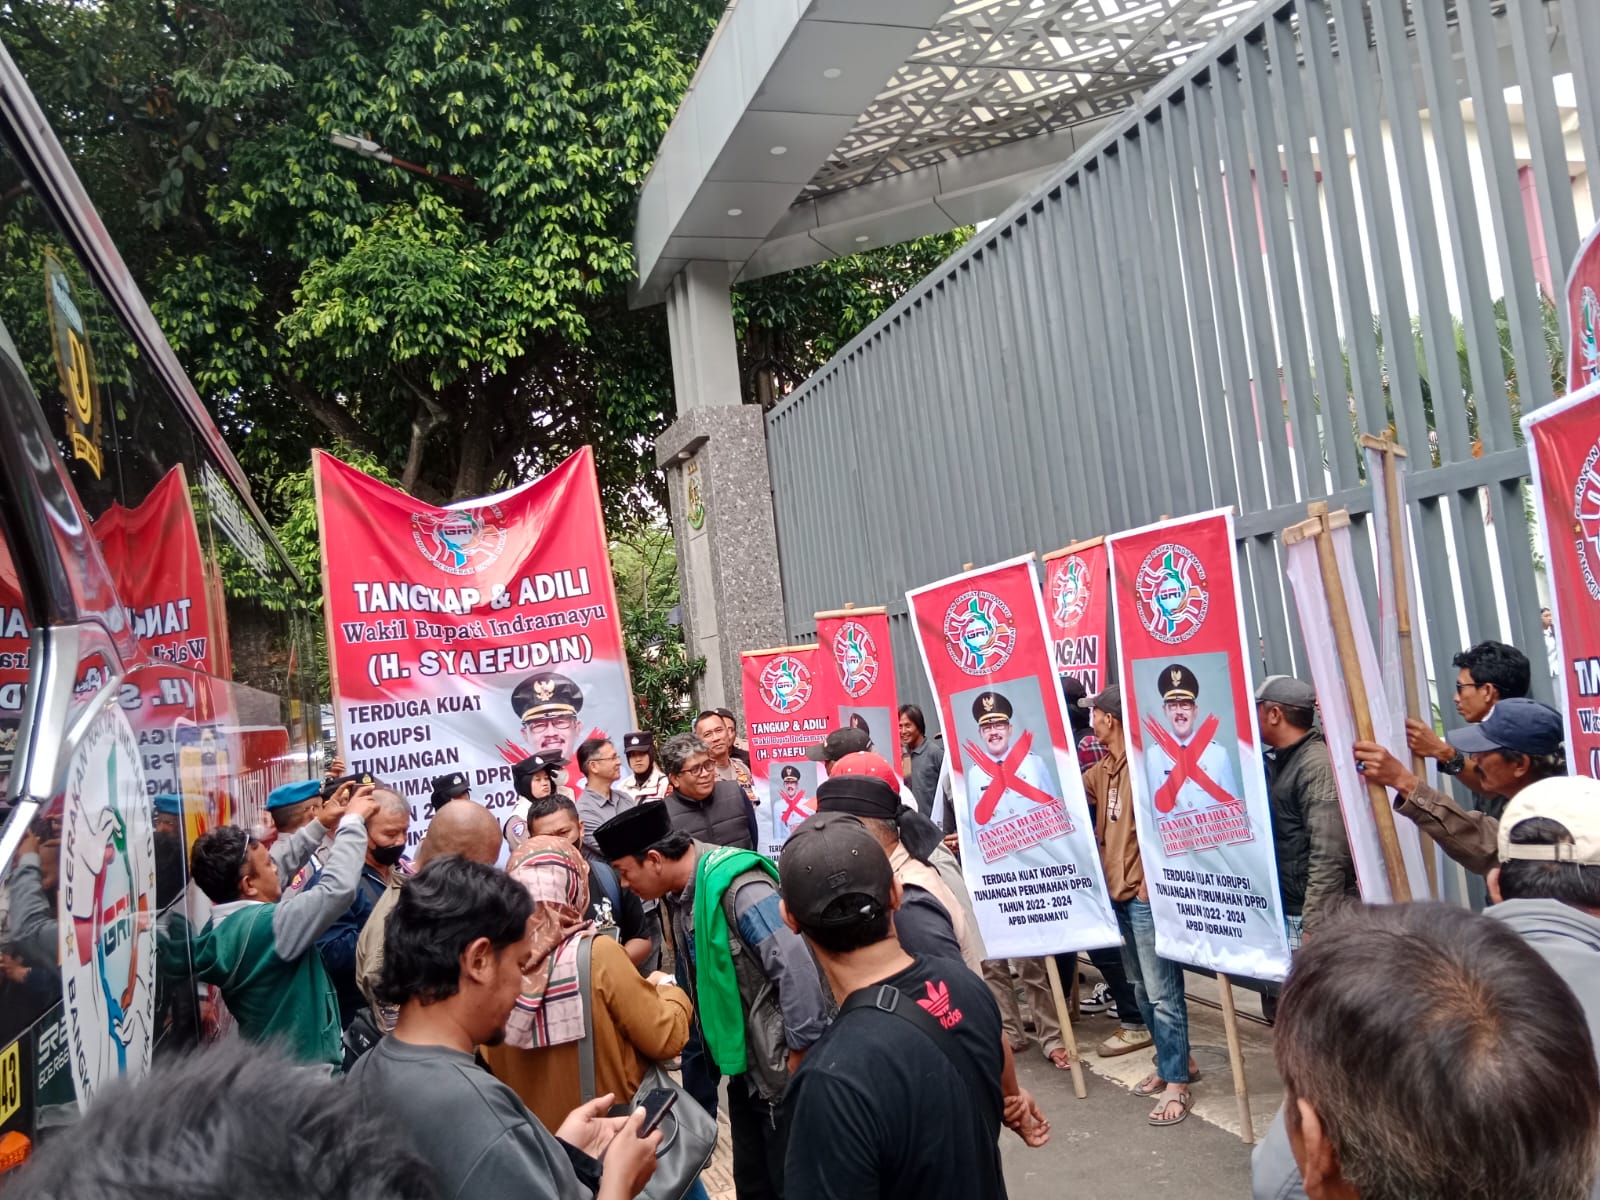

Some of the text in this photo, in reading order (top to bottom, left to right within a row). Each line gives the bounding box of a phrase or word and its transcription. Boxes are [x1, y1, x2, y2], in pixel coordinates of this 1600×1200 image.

[444, 525, 472, 536] GRI
[353, 567, 590, 614] TANGKAP & ADILI
[1160, 587, 1180, 600] GRI
[342, 603, 607, 644] Wakil Bupati Indramayu
[967, 627, 989, 640] GRI
[367, 635, 593, 686] (H. SYAEFUDIN)
[348, 695, 481, 724] TERDUGA KUAT
[752, 718, 827, 734] TANGKAP & ADILI
[351, 725, 431, 751] KORUPSI
[791, 734, 828, 743] Indramay
[352, 747, 459, 775] TUNJANGAN
[756, 747, 806, 760] (H. SYAEFU
[476, 765, 512, 785] DPR
[65, 742, 88, 912] GERAKAN
[982, 863, 1077, 886] TERDUGA KUAT KORUPSI
[1162, 868, 1195, 883] TERDUGA
[1216, 874, 1250, 890] KORUPSI
[974, 877, 1093, 901] TUNJANGAN PERUMAHAN DPRD
[1155, 883, 1196, 900] TUNJANGAN
[1244, 894, 1267, 909] DPRD
[998, 902, 1024, 914] TAHUN
[1026, 899, 1046, 912] 2022
[1052, 895, 1072, 908] 2024
[1176, 903, 1202, 916] TAHUN
[1226, 910, 1246, 924] 2024
[103, 893, 131, 957] GRI
[1008, 911, 1069, 926] APBD INDRAMAYU
[1186, 920, 1203, 931] APBD
